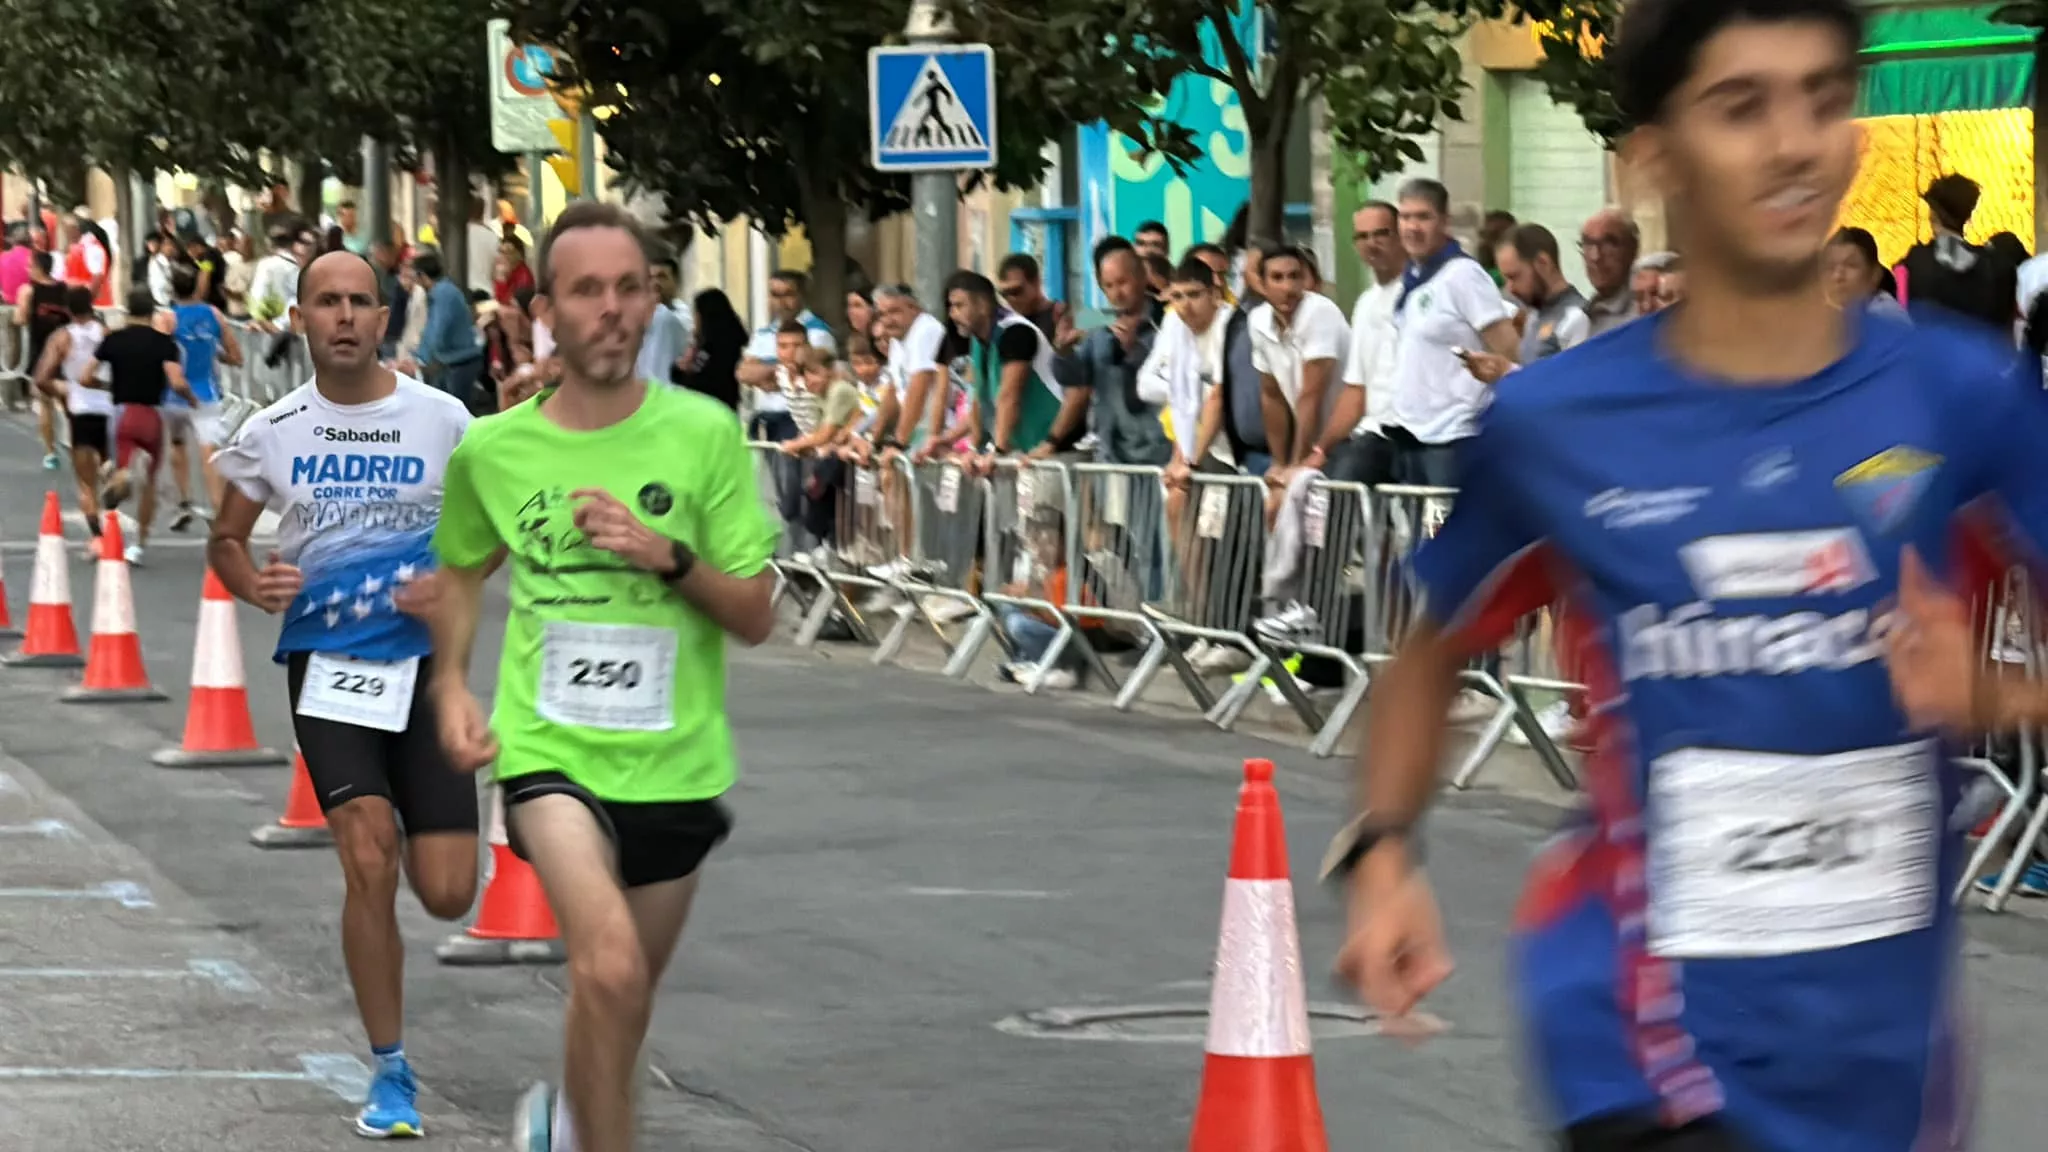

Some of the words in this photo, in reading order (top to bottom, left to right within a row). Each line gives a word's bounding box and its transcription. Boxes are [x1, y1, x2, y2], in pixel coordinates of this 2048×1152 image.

[324, 427, 401, 443] Sabadell
[290, 454, 425, 485] MADRID
[313, 487, 363, 500] CORRE
[367, 487, 398, 500] POR
[330, 671, 385, 697] 229
[568, 658, 643, 688] 250
